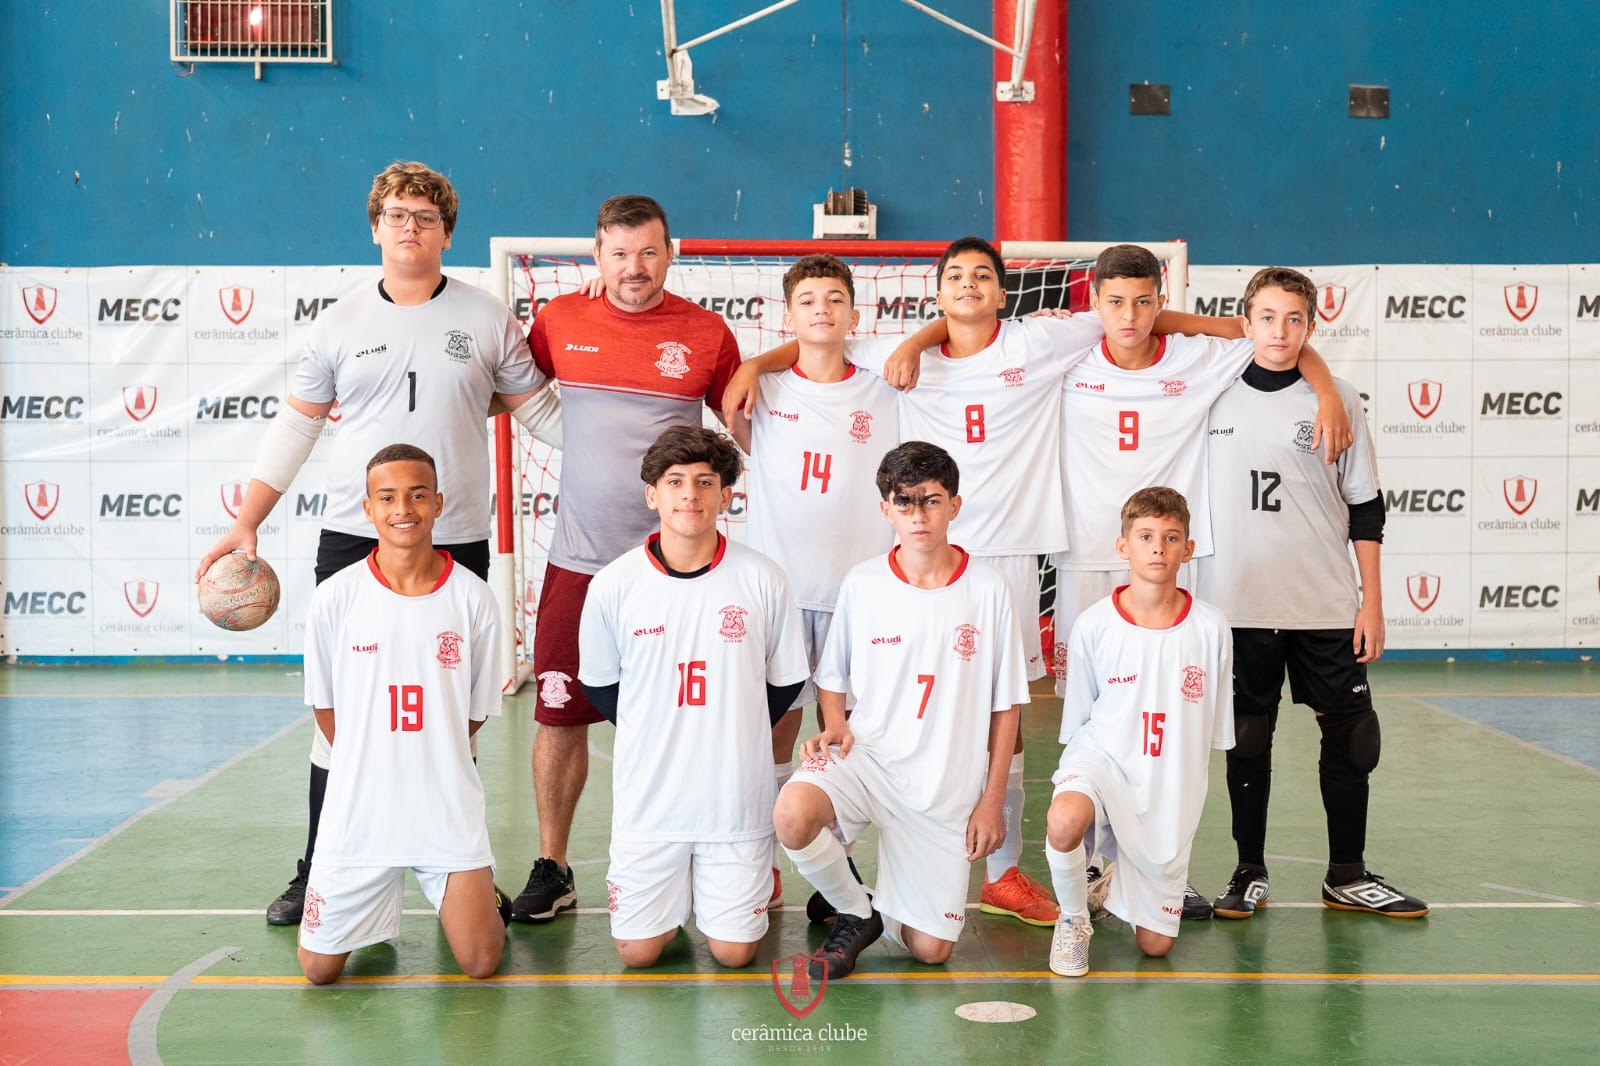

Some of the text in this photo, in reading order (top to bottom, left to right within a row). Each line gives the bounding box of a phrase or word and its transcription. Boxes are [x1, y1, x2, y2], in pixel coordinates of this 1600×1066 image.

[98, 298, 181, 321] MECC
[1386, 295, 1467, 319] MECC
[51, 327, 82, 340] clube
[248, 327, 279, 341] clube
[1340, 324, 1370, 337] clube
[1532, 324, 1562, 337] clube
[408, 371, 417, 412] 1
[1481, 391, 1562, 415] MECC
[1, 396, 84, 419] MECC
[197, 396, 280, 419] MECC
[965, 403, 985, 444] 8
[1119, 410, 1139, 451] 9
[1435, 421, 1466, 434] clube
[801, 450, 832, 494] 14
[1251, 469, 1281, 512] 12
[1385, 489, 1466, 512] MECC
[100, 494, 182, 517] MECC
[54, 523, 85, 536] clube
[1530, 518, 1561, 531] clube
[4, 591, 86, 615] MECC
[1479, 585, 1560, 609] MECC
[643, 624, 665, 636] Ludi
[1433, 614, 1464, 627] clube
[882, 635, 902, 645] Ludi
[678, 660, 706, 708] 16
[388, 684, 423, 731] 19
[917, 674, 935, 719] 7
[1142, 711, 1166, 757] 15
